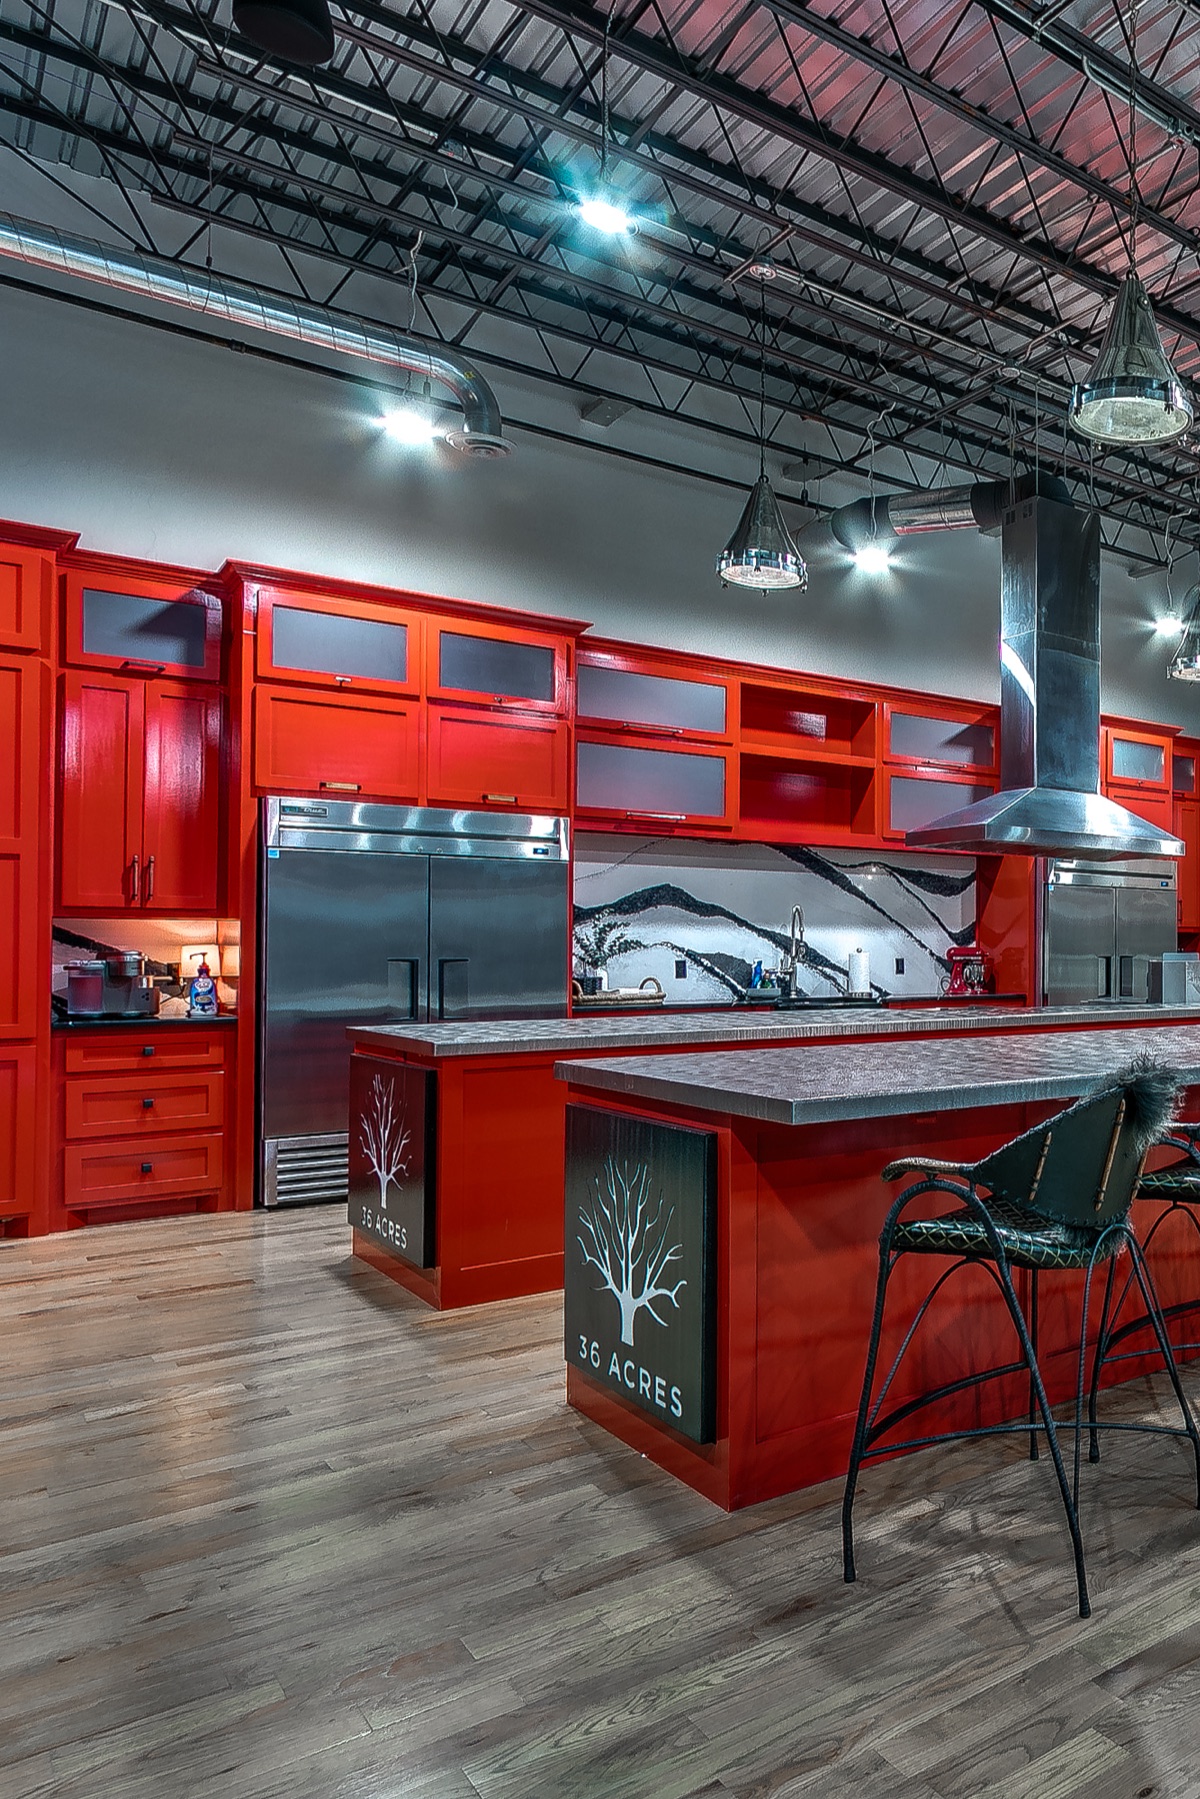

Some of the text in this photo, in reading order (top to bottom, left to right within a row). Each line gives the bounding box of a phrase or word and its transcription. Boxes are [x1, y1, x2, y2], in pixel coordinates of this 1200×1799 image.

[361, 1206, 407, 1249] 36 ACRES
[579, 1334, 683, 1418] 36 ACRES
